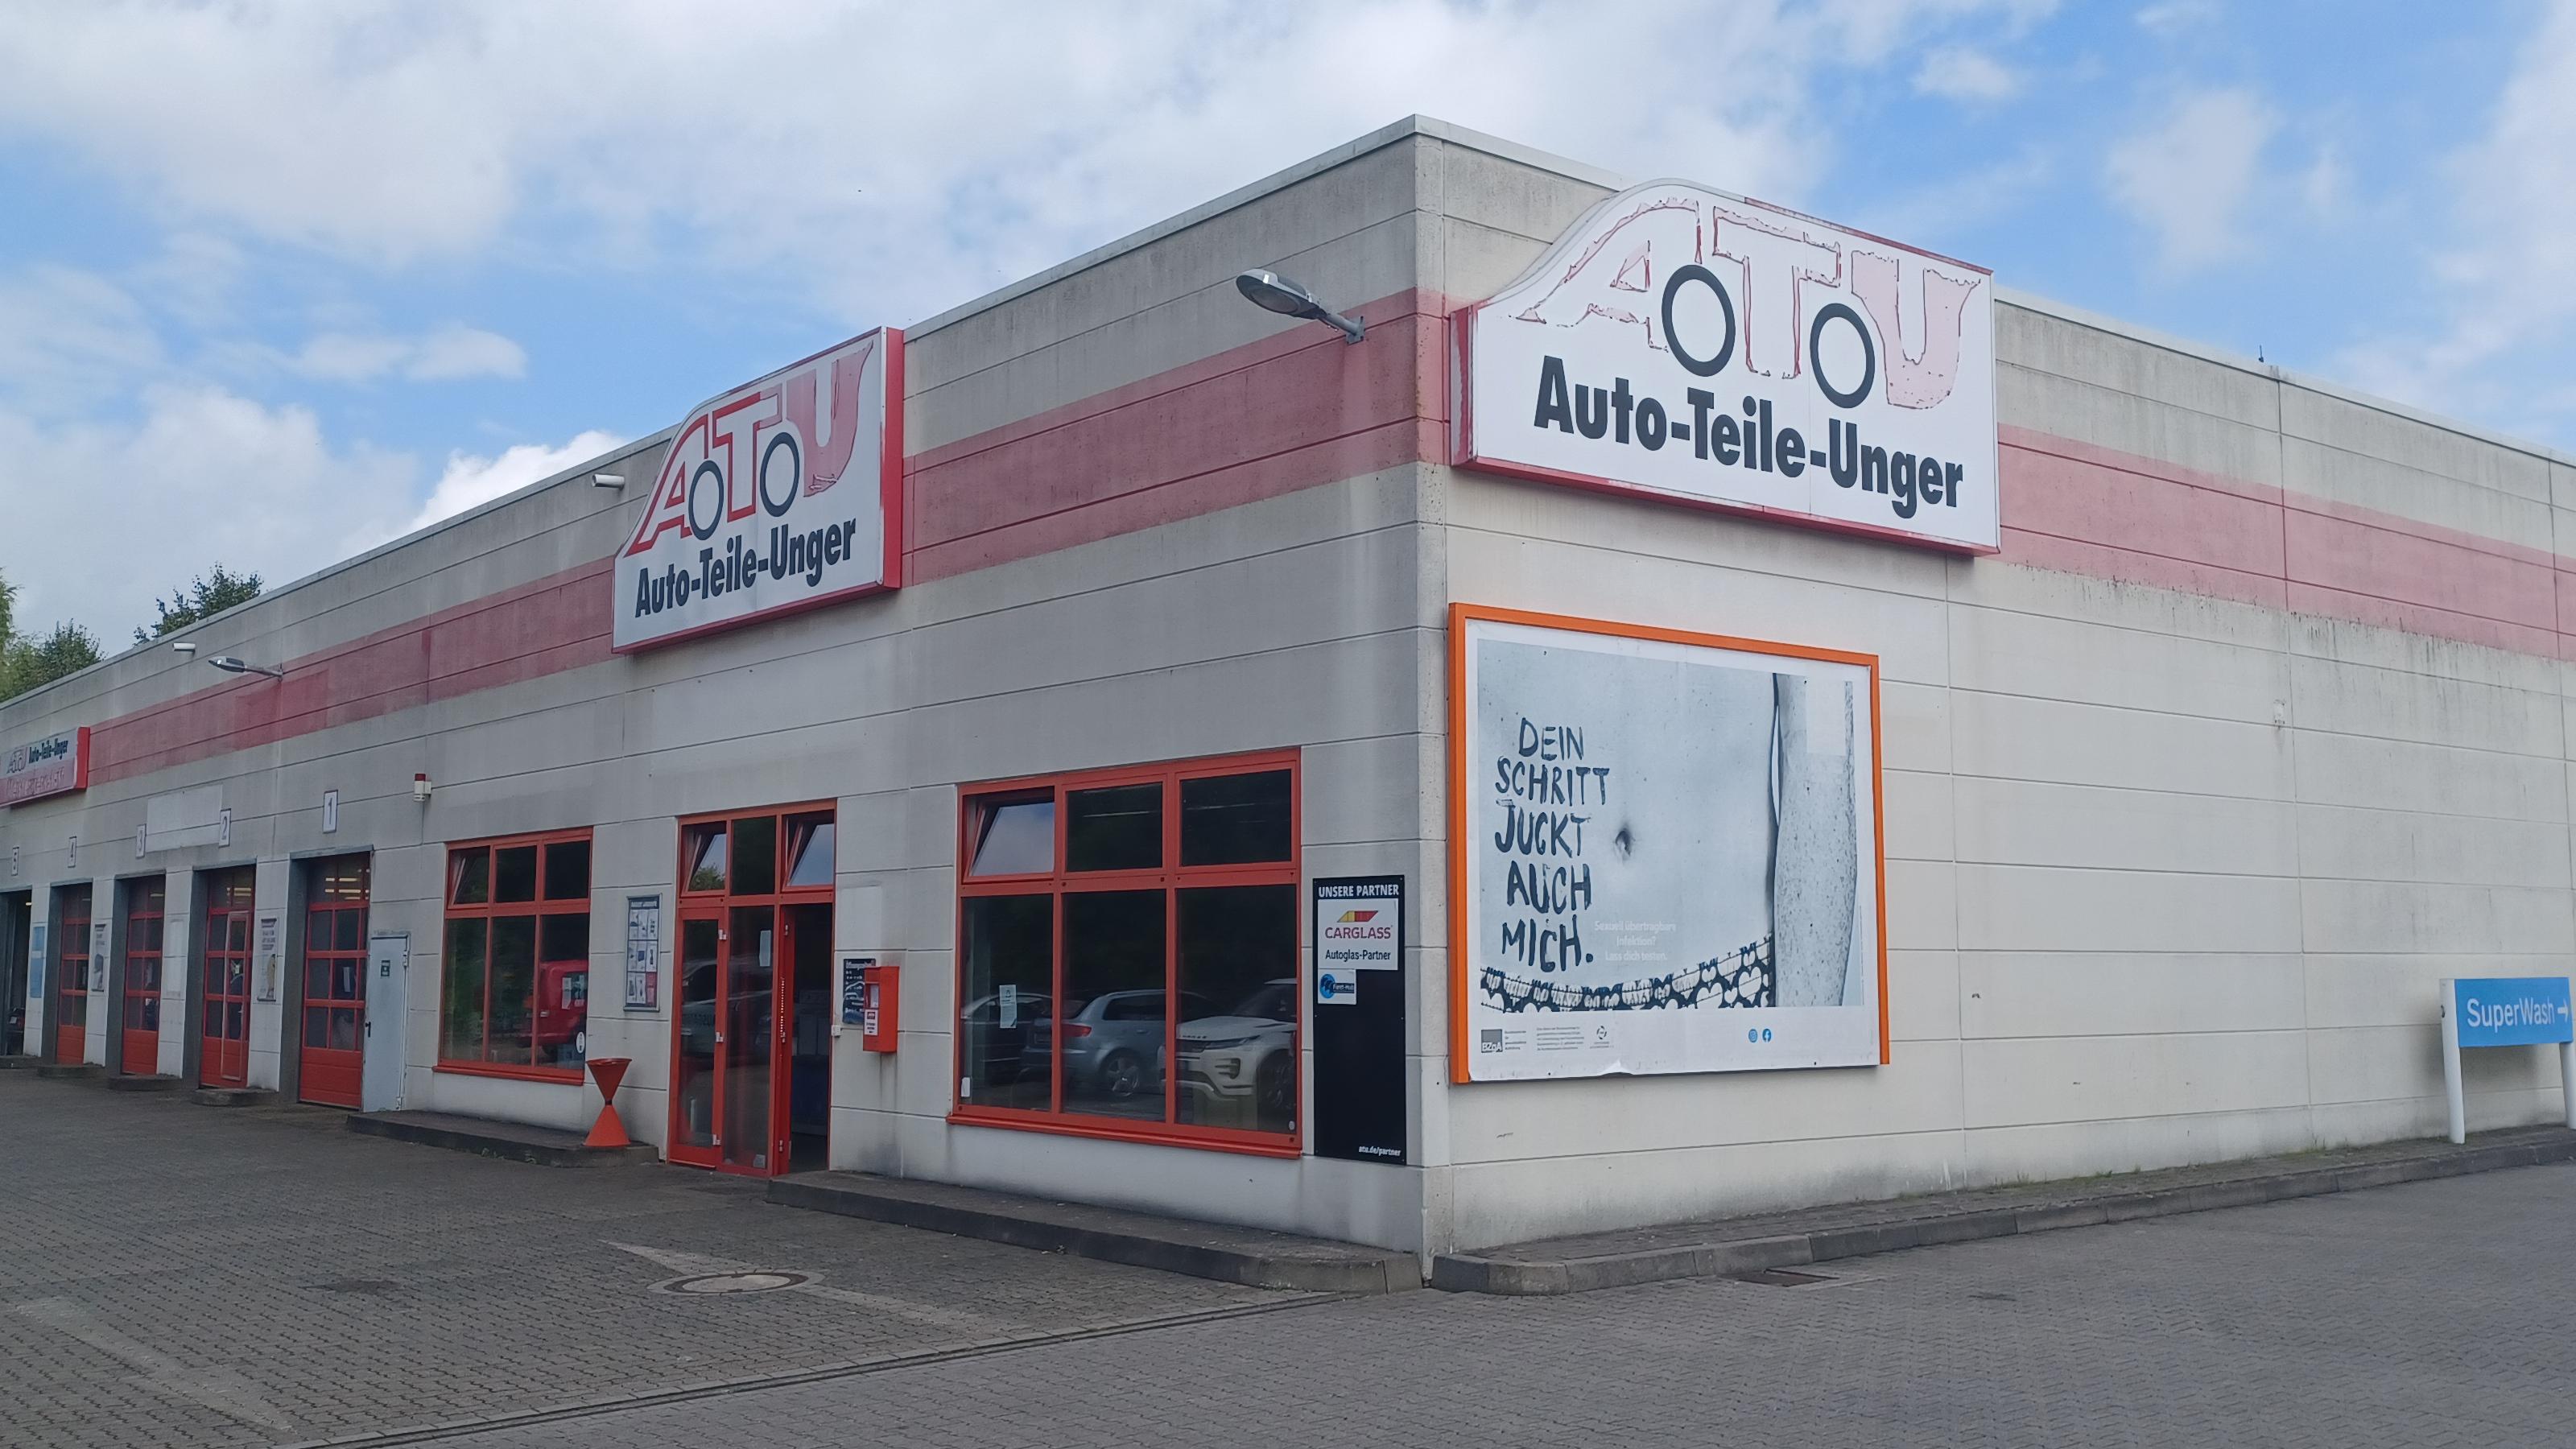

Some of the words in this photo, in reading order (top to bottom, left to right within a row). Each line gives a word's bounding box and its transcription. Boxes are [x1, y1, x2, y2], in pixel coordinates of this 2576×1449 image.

[1533, 354, 1964, 519] Auto-Teile-Unger
[634, 517, 857, 618] Auto-Teile-Unger
[1518, 717, 1584, 761] DEIN
[1495, 755, 1610, 807] SCHRITT
[221, 815, 228, 840] 2
[328, 797, 333, 825] 1
[1494, 799, 1591, 858] JUCKT
[1318, 886, 1354, 898] UNSERE
[1356, 884, 1399, 897] PARTNER
[1506, 860, 1592, 914] AUCH
[1324, 927, 1391, 939] CARGLASS
[1501, 914, 1594, 972] MICH.
[1616, 935, 1656, 947] Infektion?
[1325, 949, 1391, 962] Autoglas-Partner
[2467, 997, 2556, 1033] SuperWash
